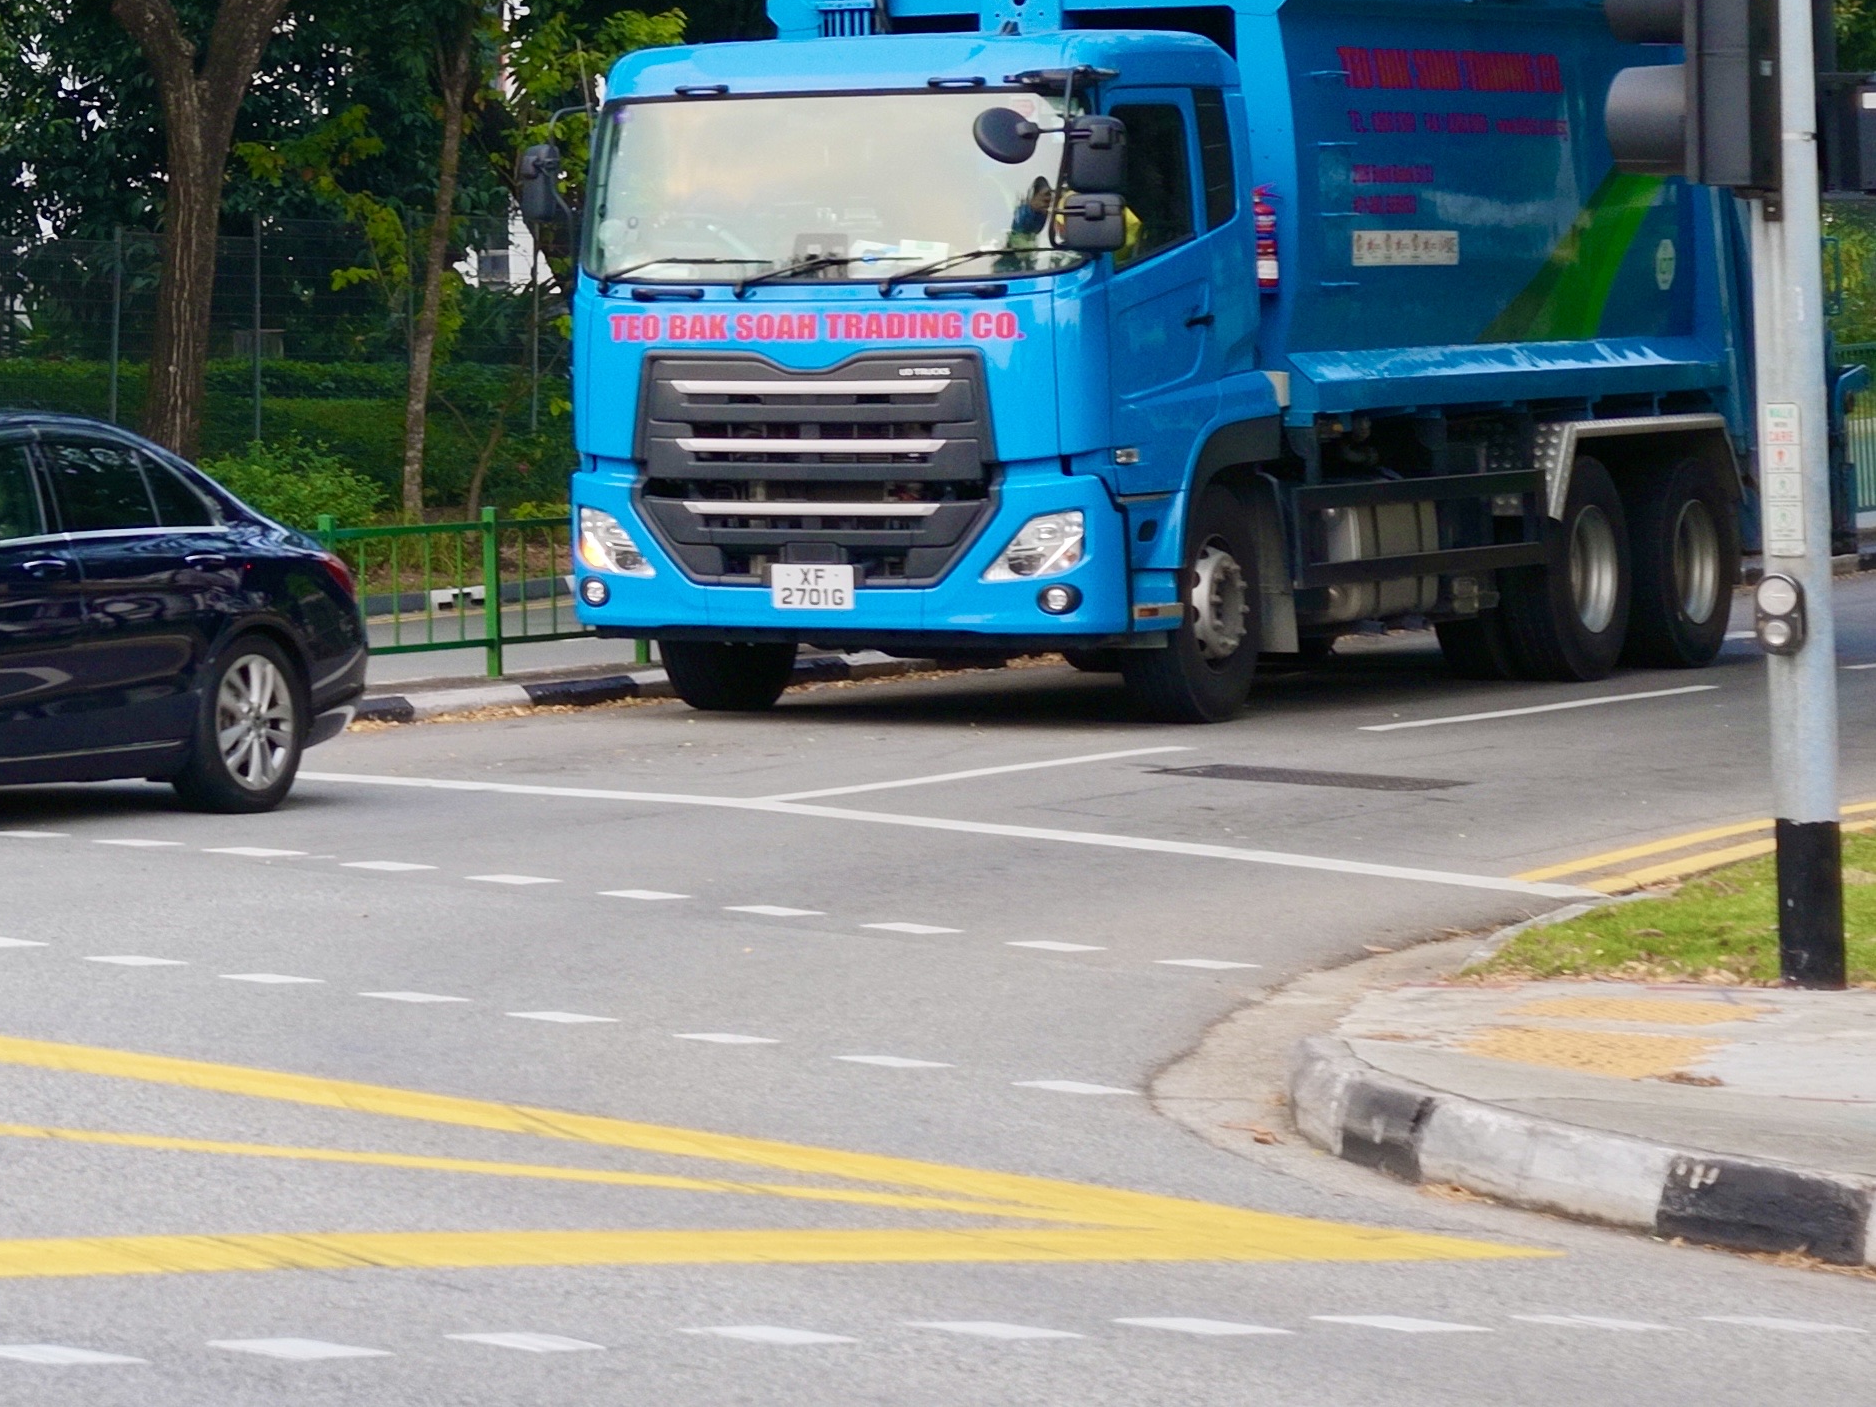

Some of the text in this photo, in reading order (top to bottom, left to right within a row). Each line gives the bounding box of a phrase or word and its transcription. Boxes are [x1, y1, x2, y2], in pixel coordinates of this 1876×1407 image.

[610, 312, 1026, 342] TEO BAK SOAH TRADING CO.
[800, 568, 825, 586] XF
[781, 587, 844, 606] 2701G
